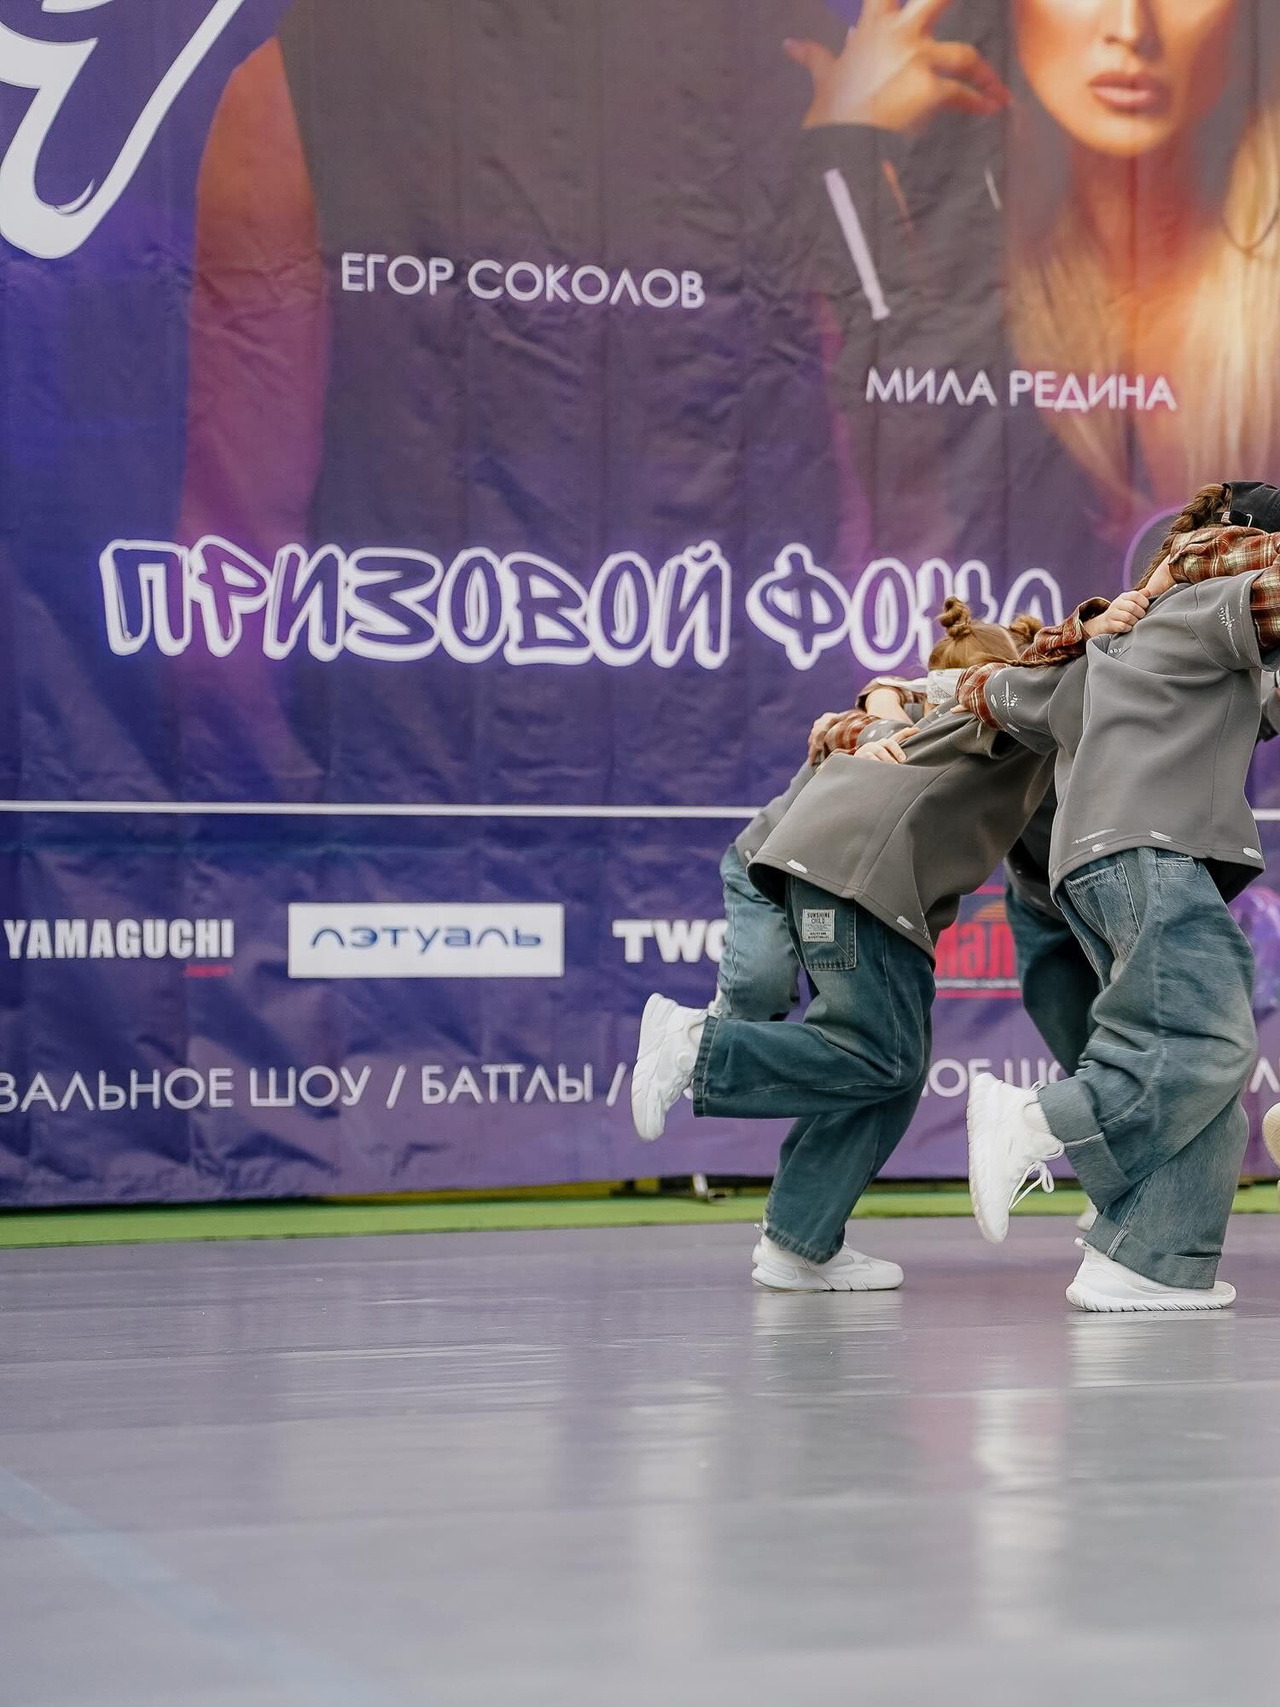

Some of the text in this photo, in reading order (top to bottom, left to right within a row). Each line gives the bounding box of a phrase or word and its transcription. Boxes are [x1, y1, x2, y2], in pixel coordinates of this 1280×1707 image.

[340, 252, 706, 309] ЕГОР СОКОЛОВ
[865, 366, 1178, 413] МИЛА РЕДИНА
[100, 534, 731, 670] ПРИЗОВОЙ
[3, 918, 235, 960] YAMAGUCHI
[249, 1064, 372, 1109] ШОУ
[422, 1061, 594, 1105] БАТТЛЫ
